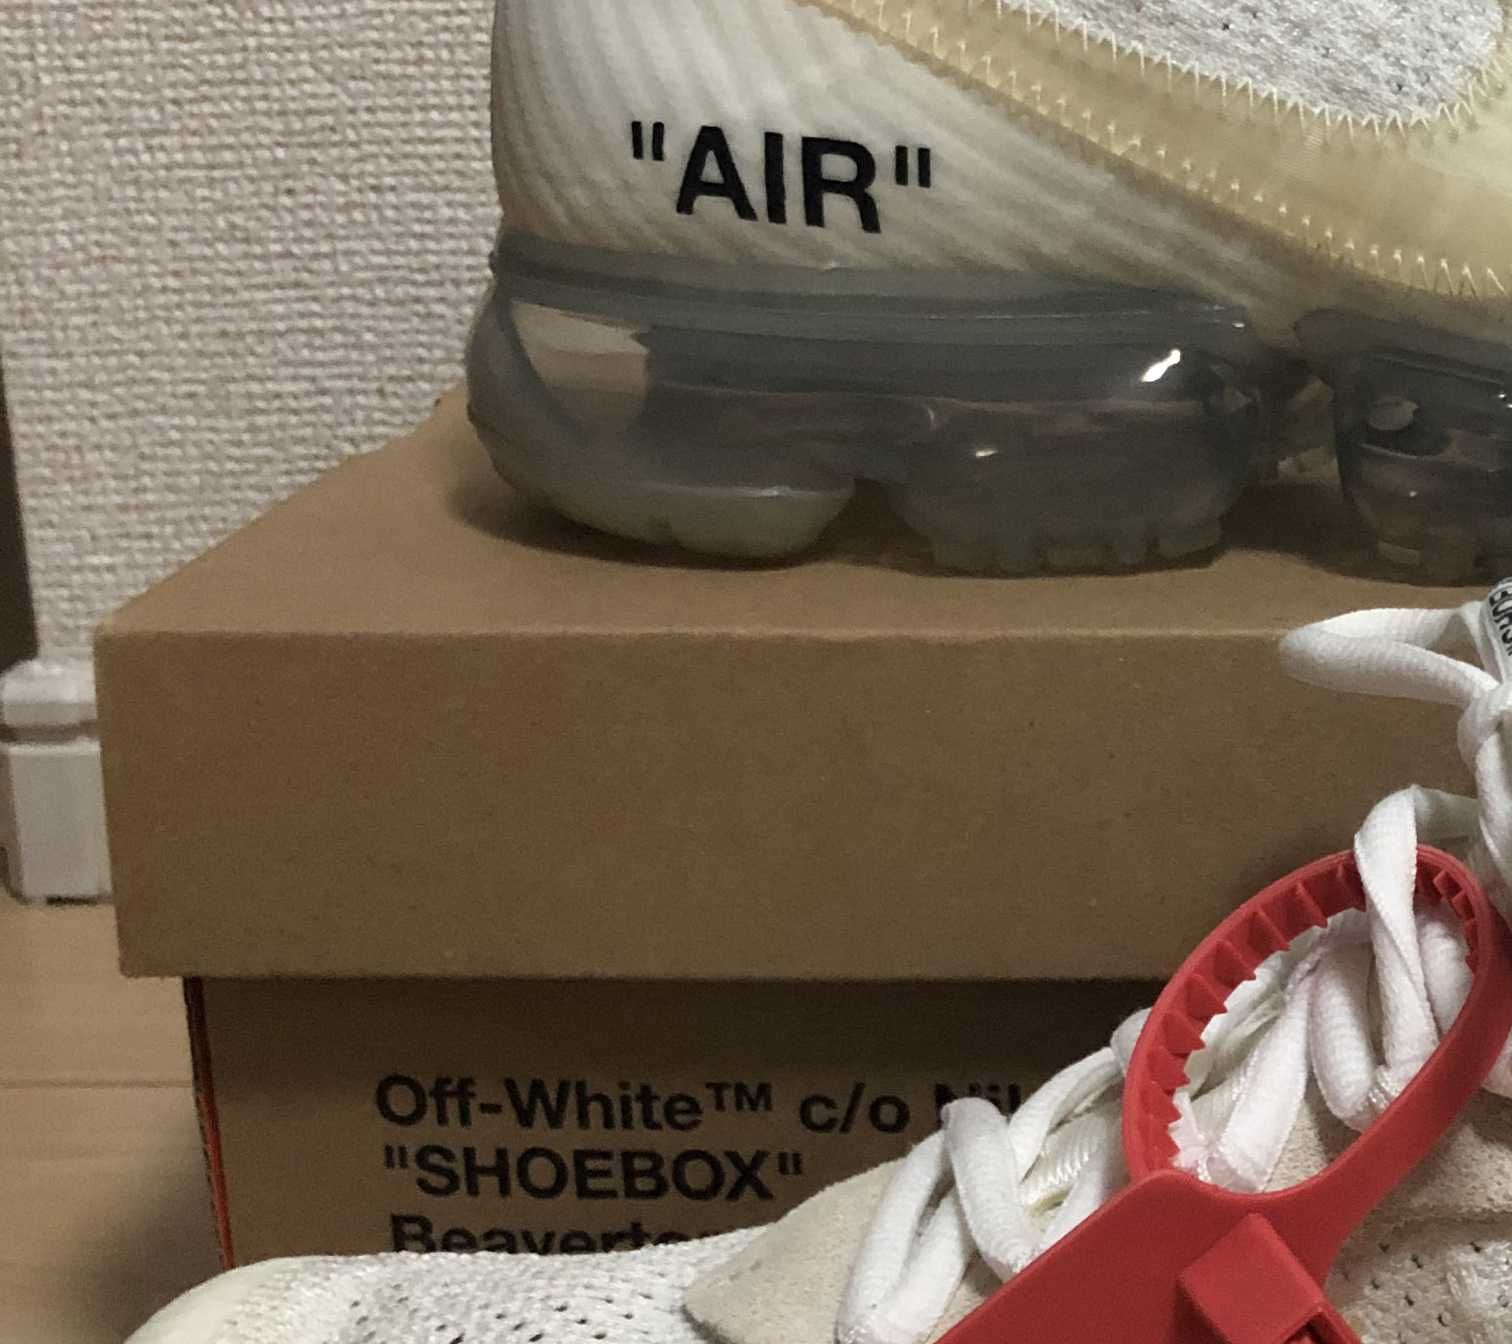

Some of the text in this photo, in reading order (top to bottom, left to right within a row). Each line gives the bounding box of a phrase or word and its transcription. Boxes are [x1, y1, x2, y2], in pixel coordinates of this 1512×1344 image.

[630, 120, 931, 233] "AIR"
[799, 1080, 912, 1133] c/o
[383, 1144, 803, 1201] "SHOEBOX"
